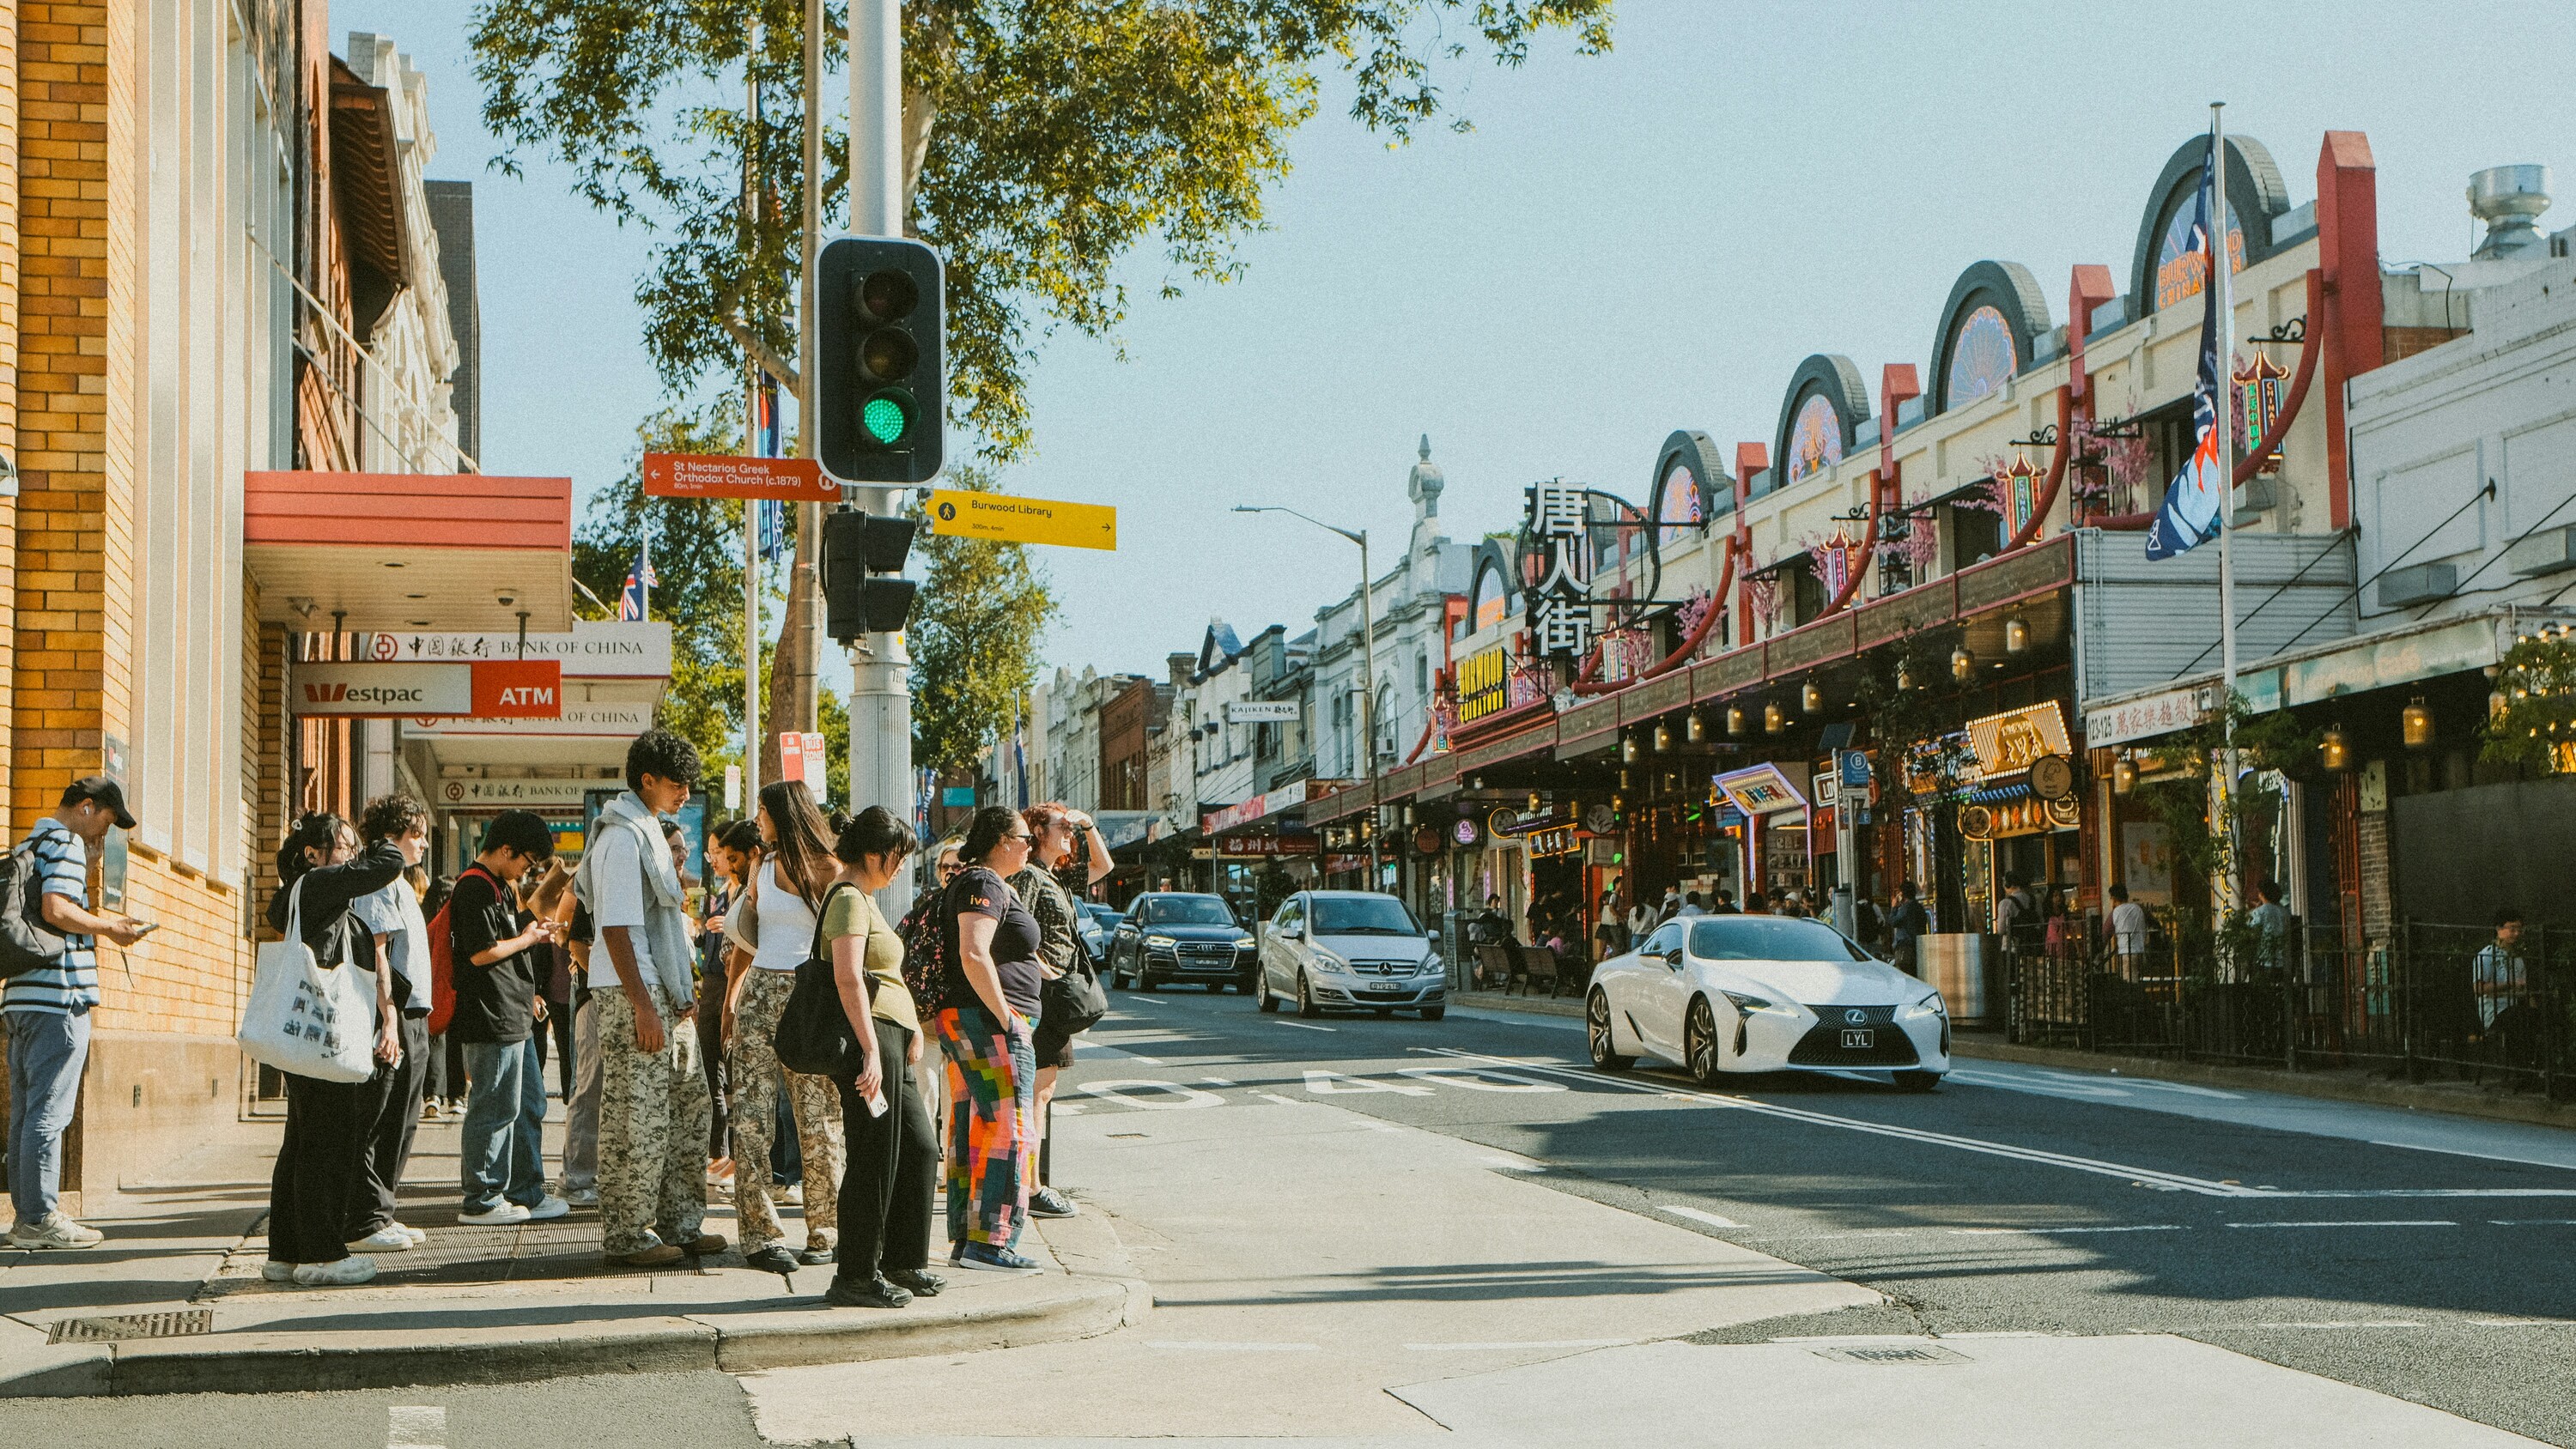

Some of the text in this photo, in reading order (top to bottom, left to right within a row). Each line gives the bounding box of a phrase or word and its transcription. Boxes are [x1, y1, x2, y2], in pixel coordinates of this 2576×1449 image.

[2158, 227, 2242, 293] BURWD
[2158, 254, 2242, 310] CHINAN
[2266, 382, 2275, 427] CHINAT
[673, 461, 769, 475] St Nectarios Greek
[673, 473, 801, 488] Orthodox Church (c.1879)
[971, 500, 1053, 518] Burwood Library
[1531, 477, 1593, 657] 唐人街
[501, 641, 550, 654] BANK
[556, 640, 579, 653] OF
[584, 640, 643, 654] CHINA
[1460, 646, 1503, 699] BURWOOD
[304, 683, 554, 706] Westpac ATM
[568, 712, 639, 724] OF CHINA
[2087, 714, 2112, 742] 123-125
[805, 738, 822, 749] BUS
[1855, 756, 1862, 767] B
[530, 786, 562, 796] BANK
[565, 786, 580, 795] OF
[1846, 1034, 1868, 1046] LYL
[1302, 1067, 1570, 1096] 40
